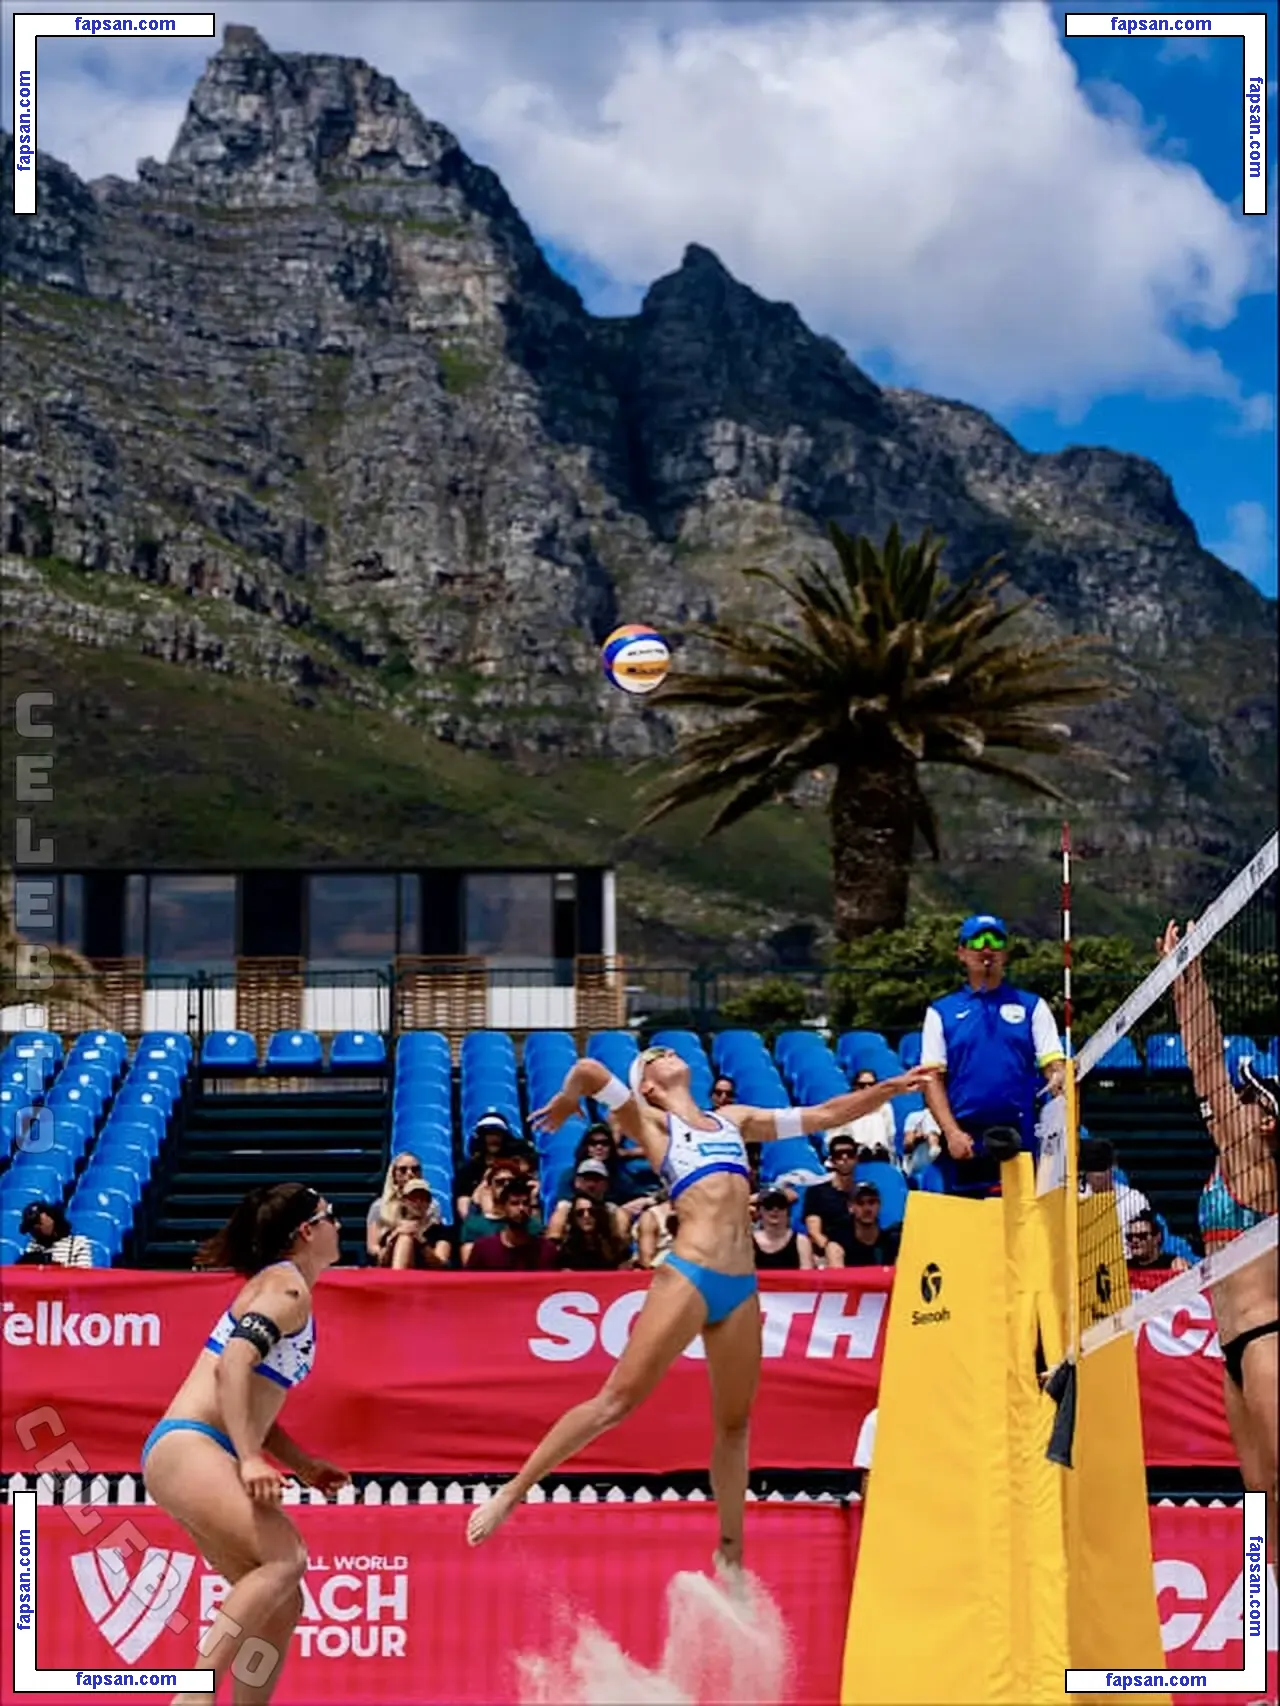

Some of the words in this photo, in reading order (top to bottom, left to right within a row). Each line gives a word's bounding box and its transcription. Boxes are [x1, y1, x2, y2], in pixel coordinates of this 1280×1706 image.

[2, 1301, 161, 1347] elkom
[528, 1289, 887, 1362] SOTH
[333, 1555, 409, 1571] WORLD
[200, 1574, 409, 1622] BACH
[293, 1625, 408, 1658] TOUR
